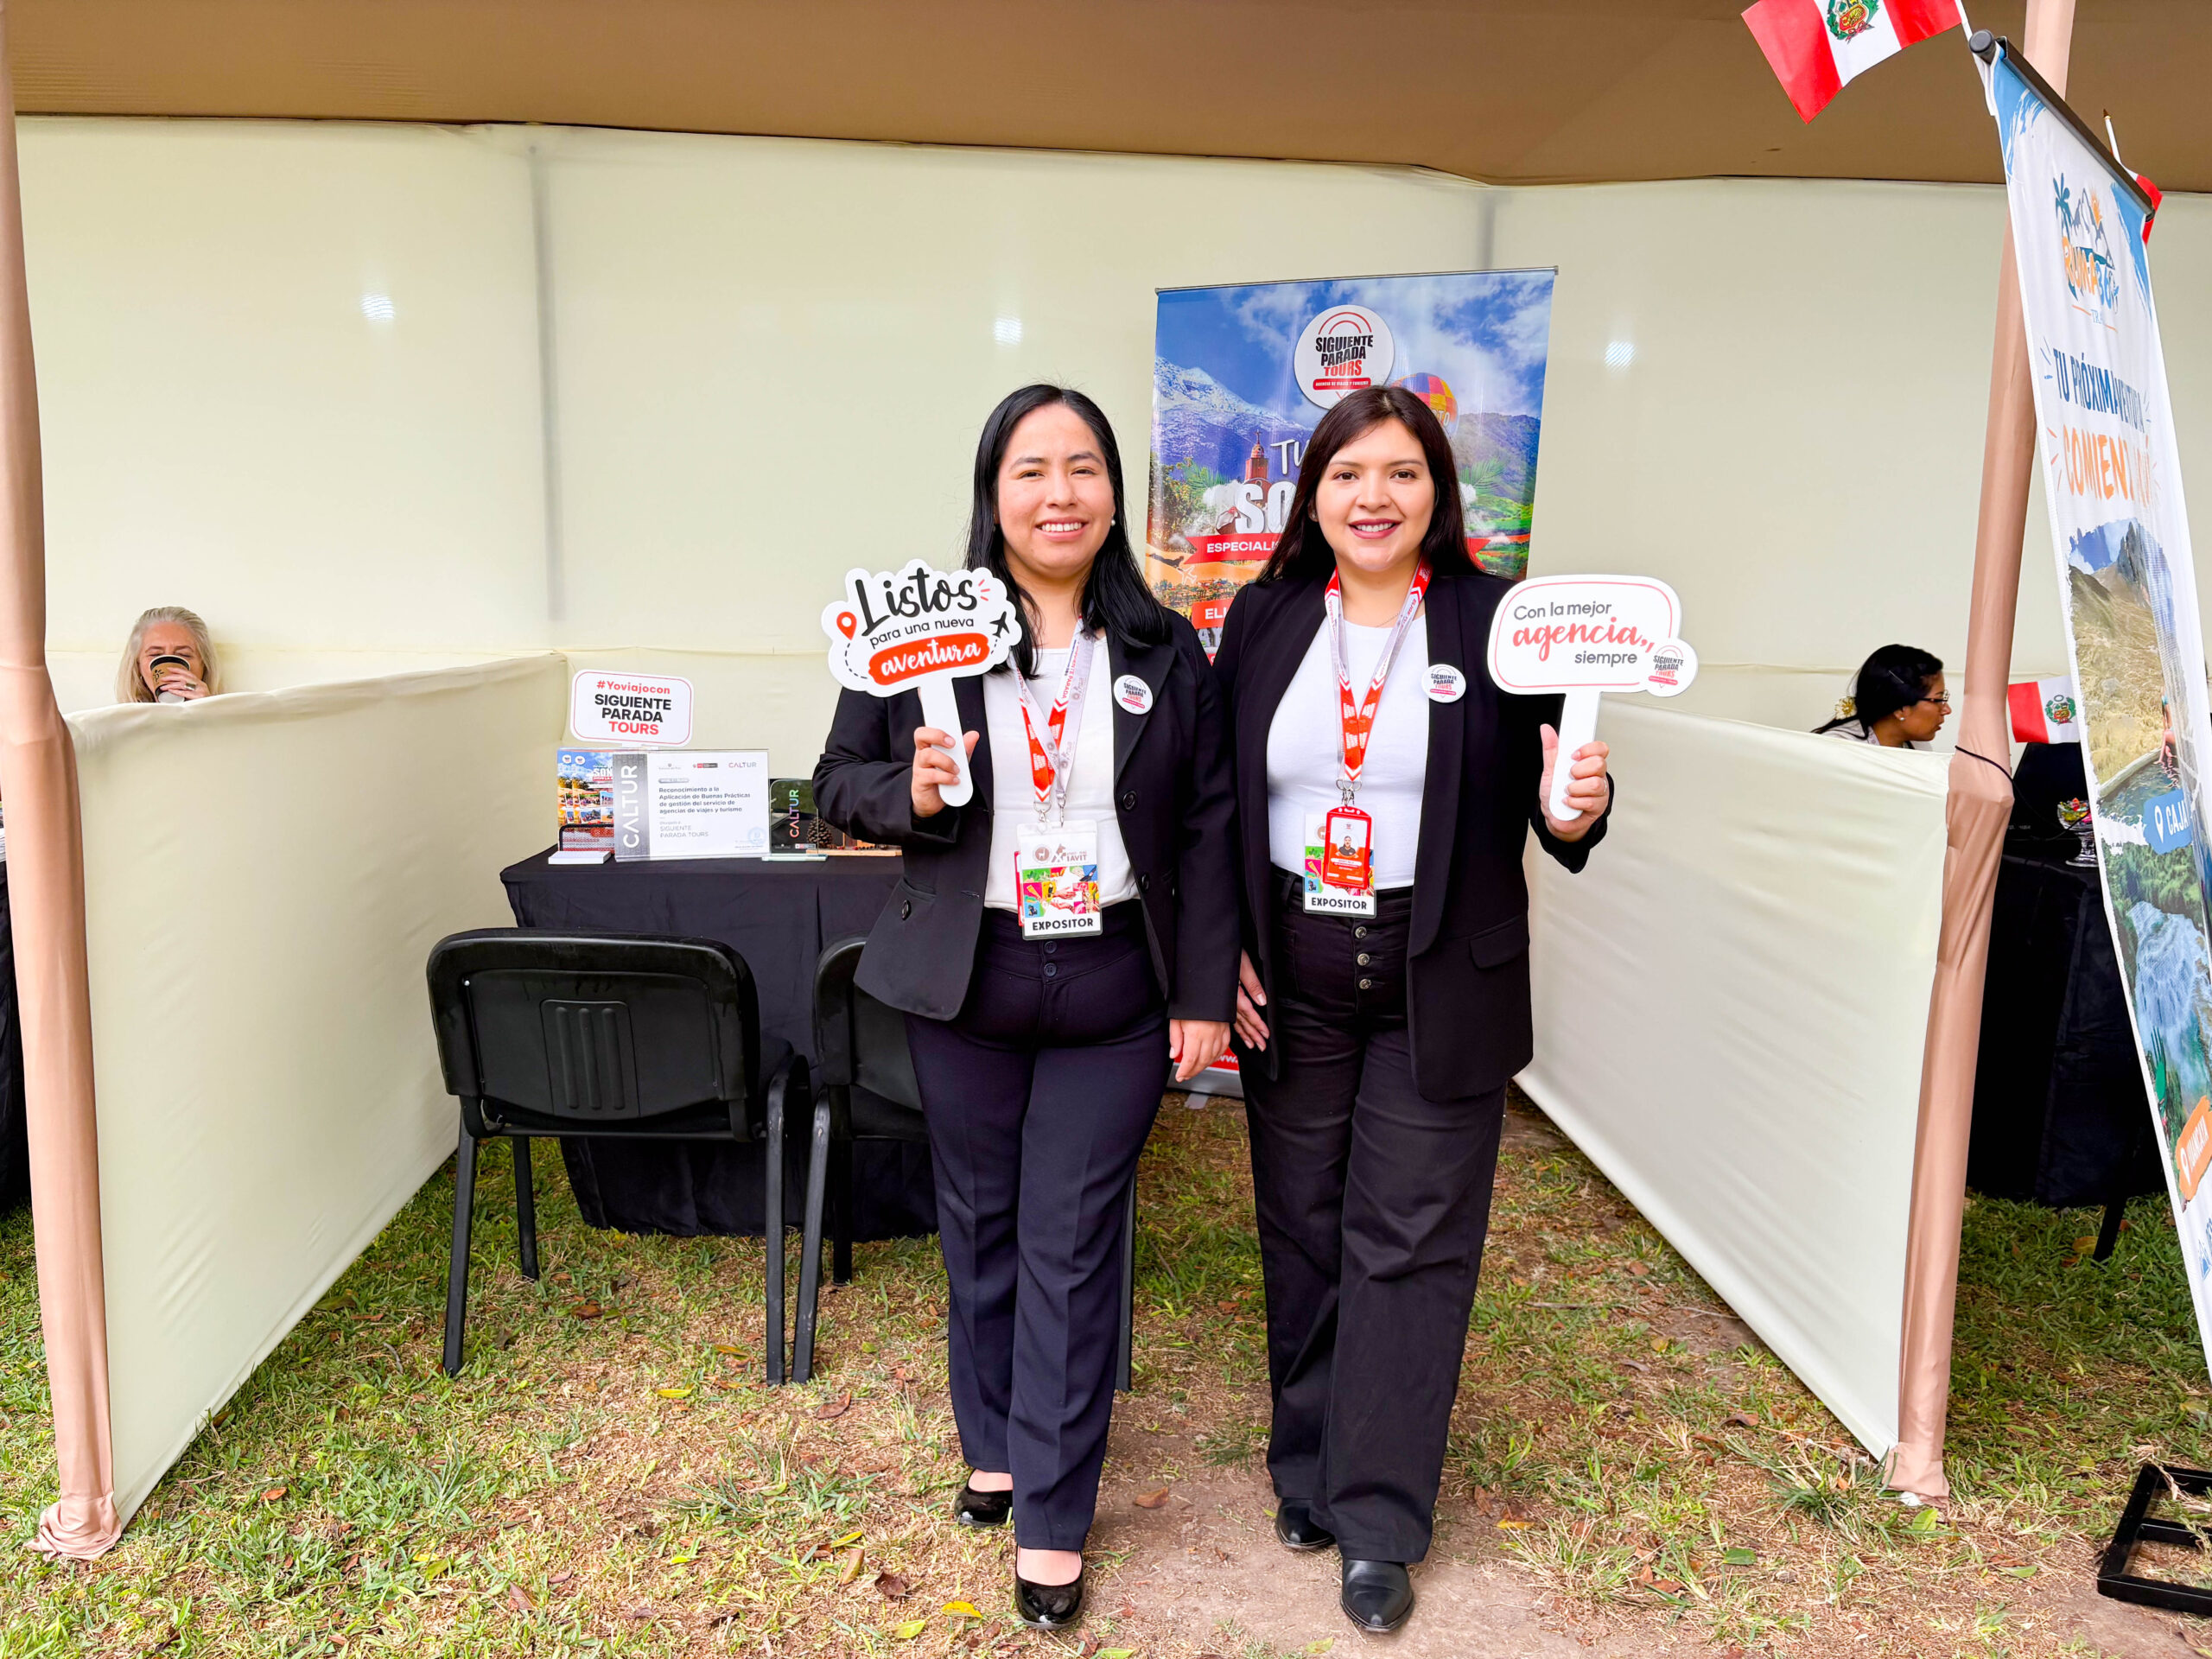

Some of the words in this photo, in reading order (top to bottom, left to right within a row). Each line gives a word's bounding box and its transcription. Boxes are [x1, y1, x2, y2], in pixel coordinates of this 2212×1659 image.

[1316, 335, 1374, 353] SIGUIENTE
[1321, 346, 1366, 366] PARADA
[1324, 359, 1363, 377] TOURS
[2053, 348, 2070, 403] TU
[855, 567, 978, 637] Listos
[1514, 605, 1546, 620] Con
[1550, 602, 1564, 617] la
[1567, 601, 1612, 617] mejor
[869, 628, 901, 650] para
[905, 621, 931, 635] una
[934, 617, 974, 631] nueva
[880, 638, 982, 677] aventura
[1574, 651, 1637, 668] siempre
[596, 680, 671, 695] #Yoviajocon
[594, 694, 671, 710] SIGUIENTE
[601, 707, 663, 722] PARADA
[608, 721, 659, 735] TOURS
[789, 789, 800, 838] CALTUR
[1311, 897, 1367, 910] EXPOSITOR
[1033, 918, 1093, 931] EXPOSITOR
